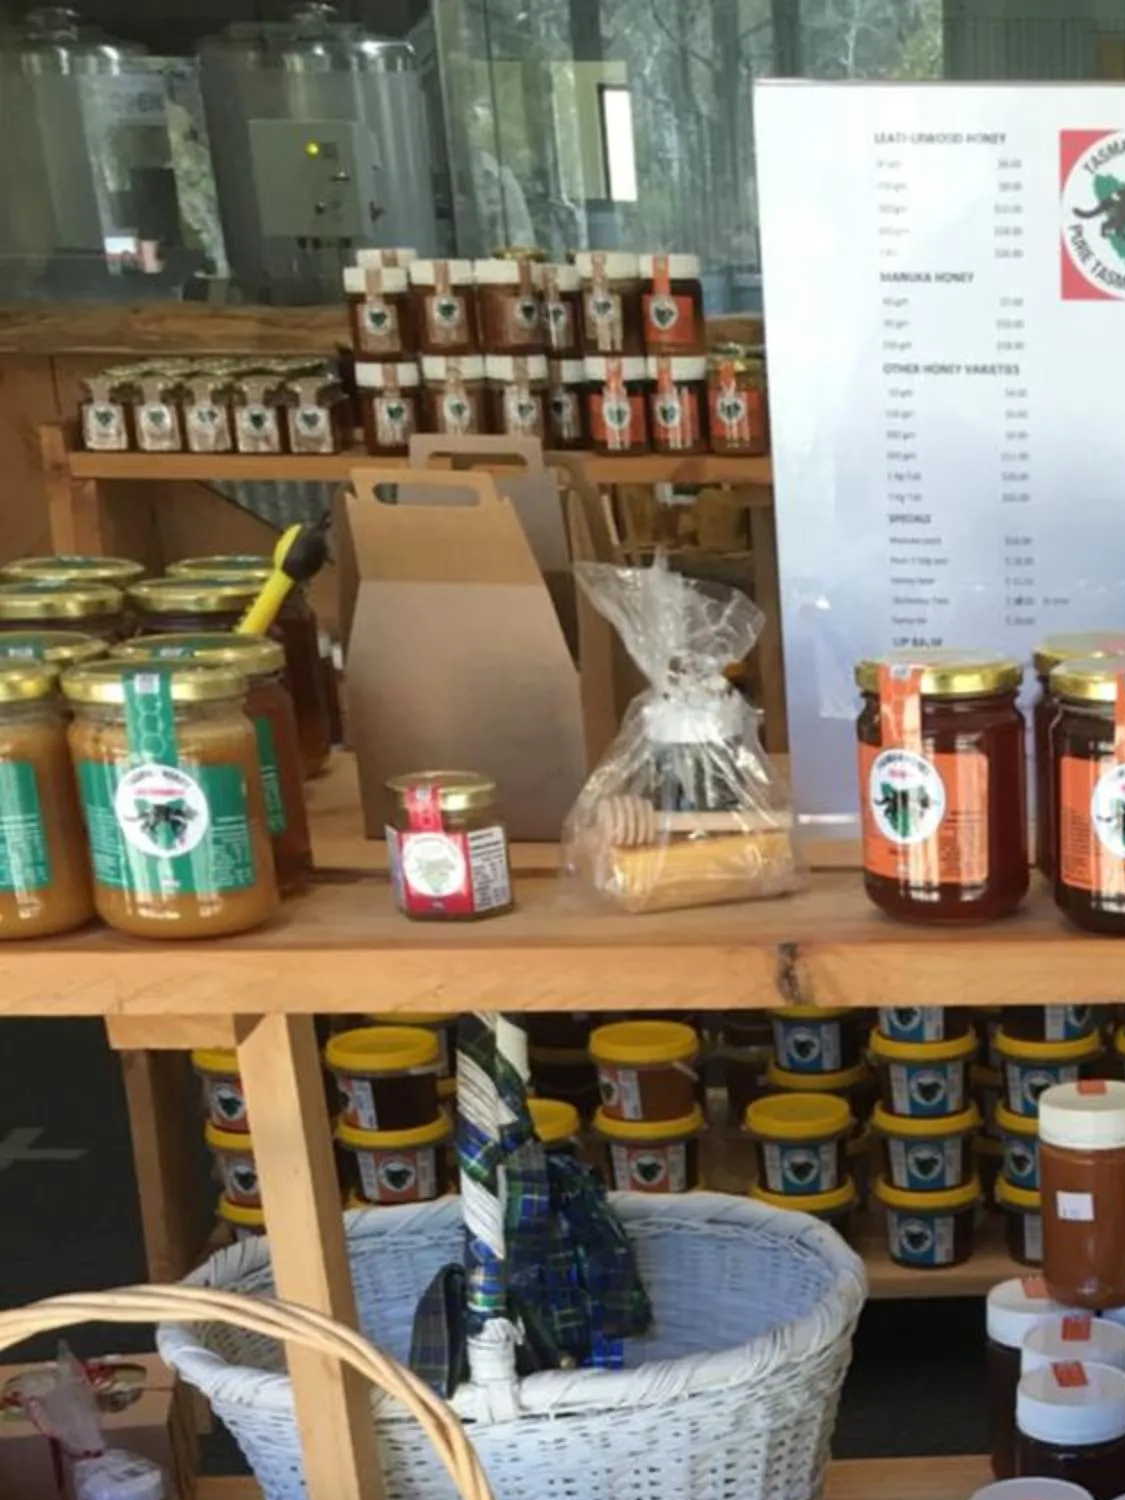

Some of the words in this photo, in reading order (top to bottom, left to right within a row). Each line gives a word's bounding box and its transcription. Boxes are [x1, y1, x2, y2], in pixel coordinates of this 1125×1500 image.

[966, 132, 1006, 145] HONEY
[1068, 223, 1095, 263] PURE
[880, 272, 931, 283] MANUKA
[934, 272, 974, 283] HONEY
[882, 363, 919, 375] OTHER
[922, 363, 961, 375] HONEY
[888, 514, 931, 524] SPECIALS
